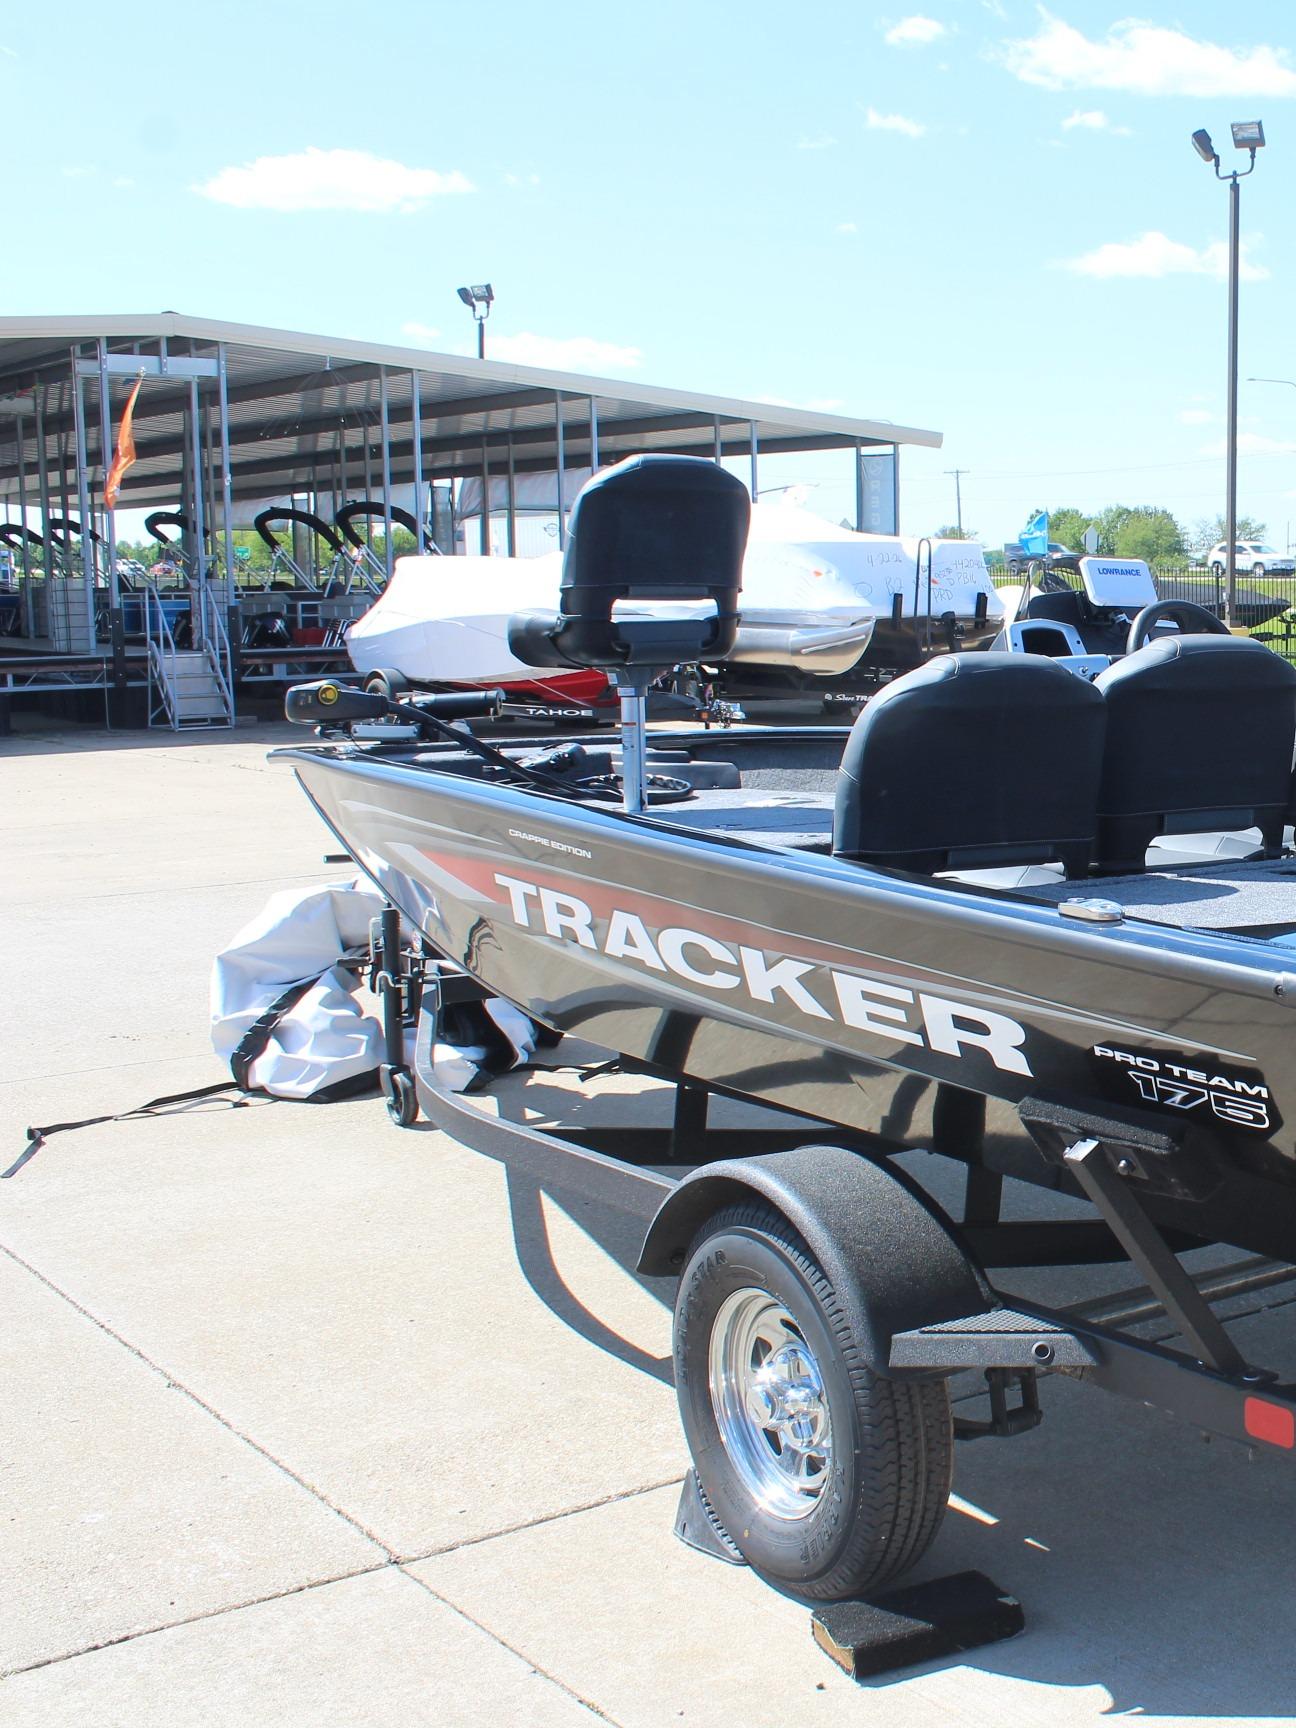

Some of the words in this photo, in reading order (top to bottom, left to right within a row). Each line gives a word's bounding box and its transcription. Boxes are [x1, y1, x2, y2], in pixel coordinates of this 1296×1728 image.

[1097, 567, 1142, 577] LOWRANCE
[526, 708, 593, 717] TAHOE
[508, 828, 551, 847] CRAPPIE
[550, 840, 592, 859] EDITION
[494, 873, 1034, 1078] TRACKER
[1093, 1045, 1160, 1071] PRO
[1165, 1063, 1269, 1098] TEAM
[1127, 1071, 1270, 1129] 175
